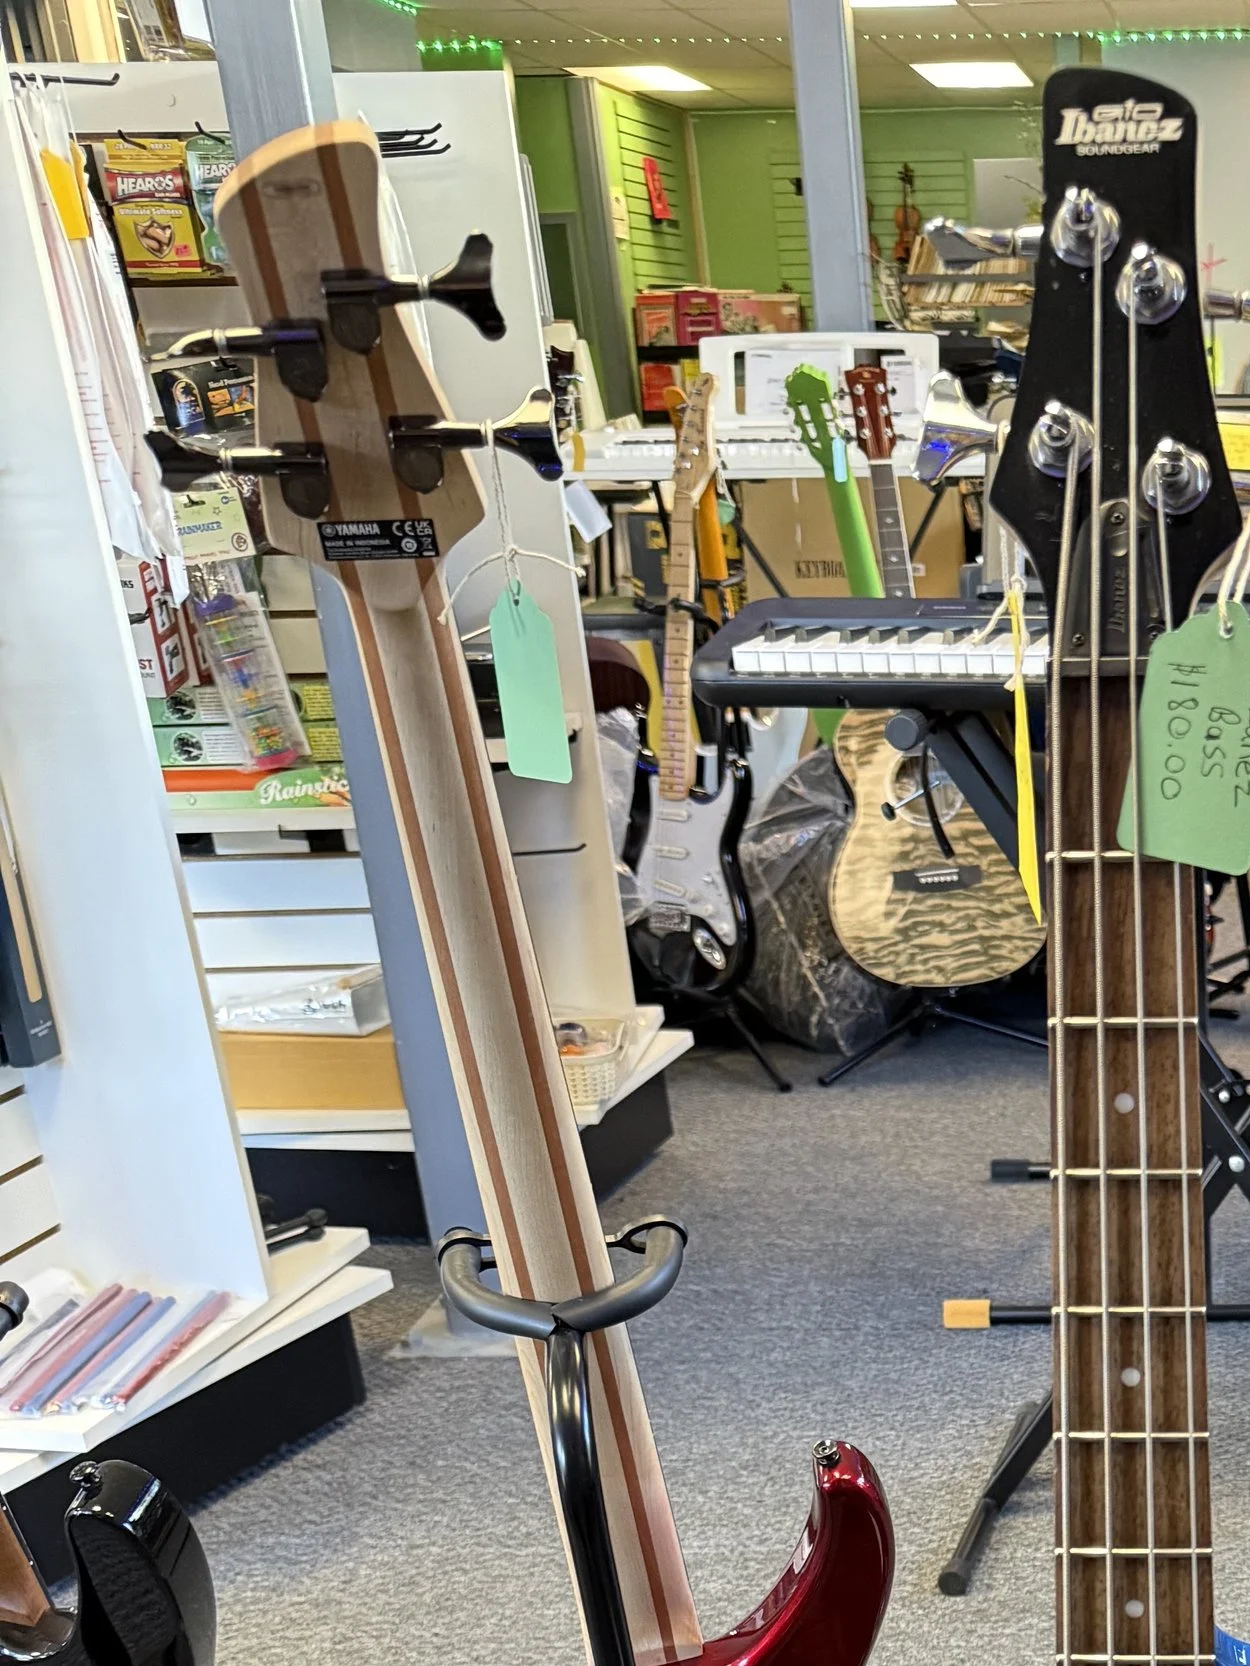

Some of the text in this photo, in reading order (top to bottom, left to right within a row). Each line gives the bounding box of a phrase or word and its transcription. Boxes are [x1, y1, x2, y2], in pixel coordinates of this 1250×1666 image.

[1054, 108, 1183, 145] Ibanez
[1076, 143, 1160, 156] SOUNDGEAR
[199, 162, 236, 180] HEAR
[116, 175, 175, 198] HEAROS
[335, 523, 381, 537] YAMAHA
[1107, 566, 1128, 634] Ibanez
[1201, 706, 1242, 779] Bass
[259, 775, 351, 805] Rainstic
